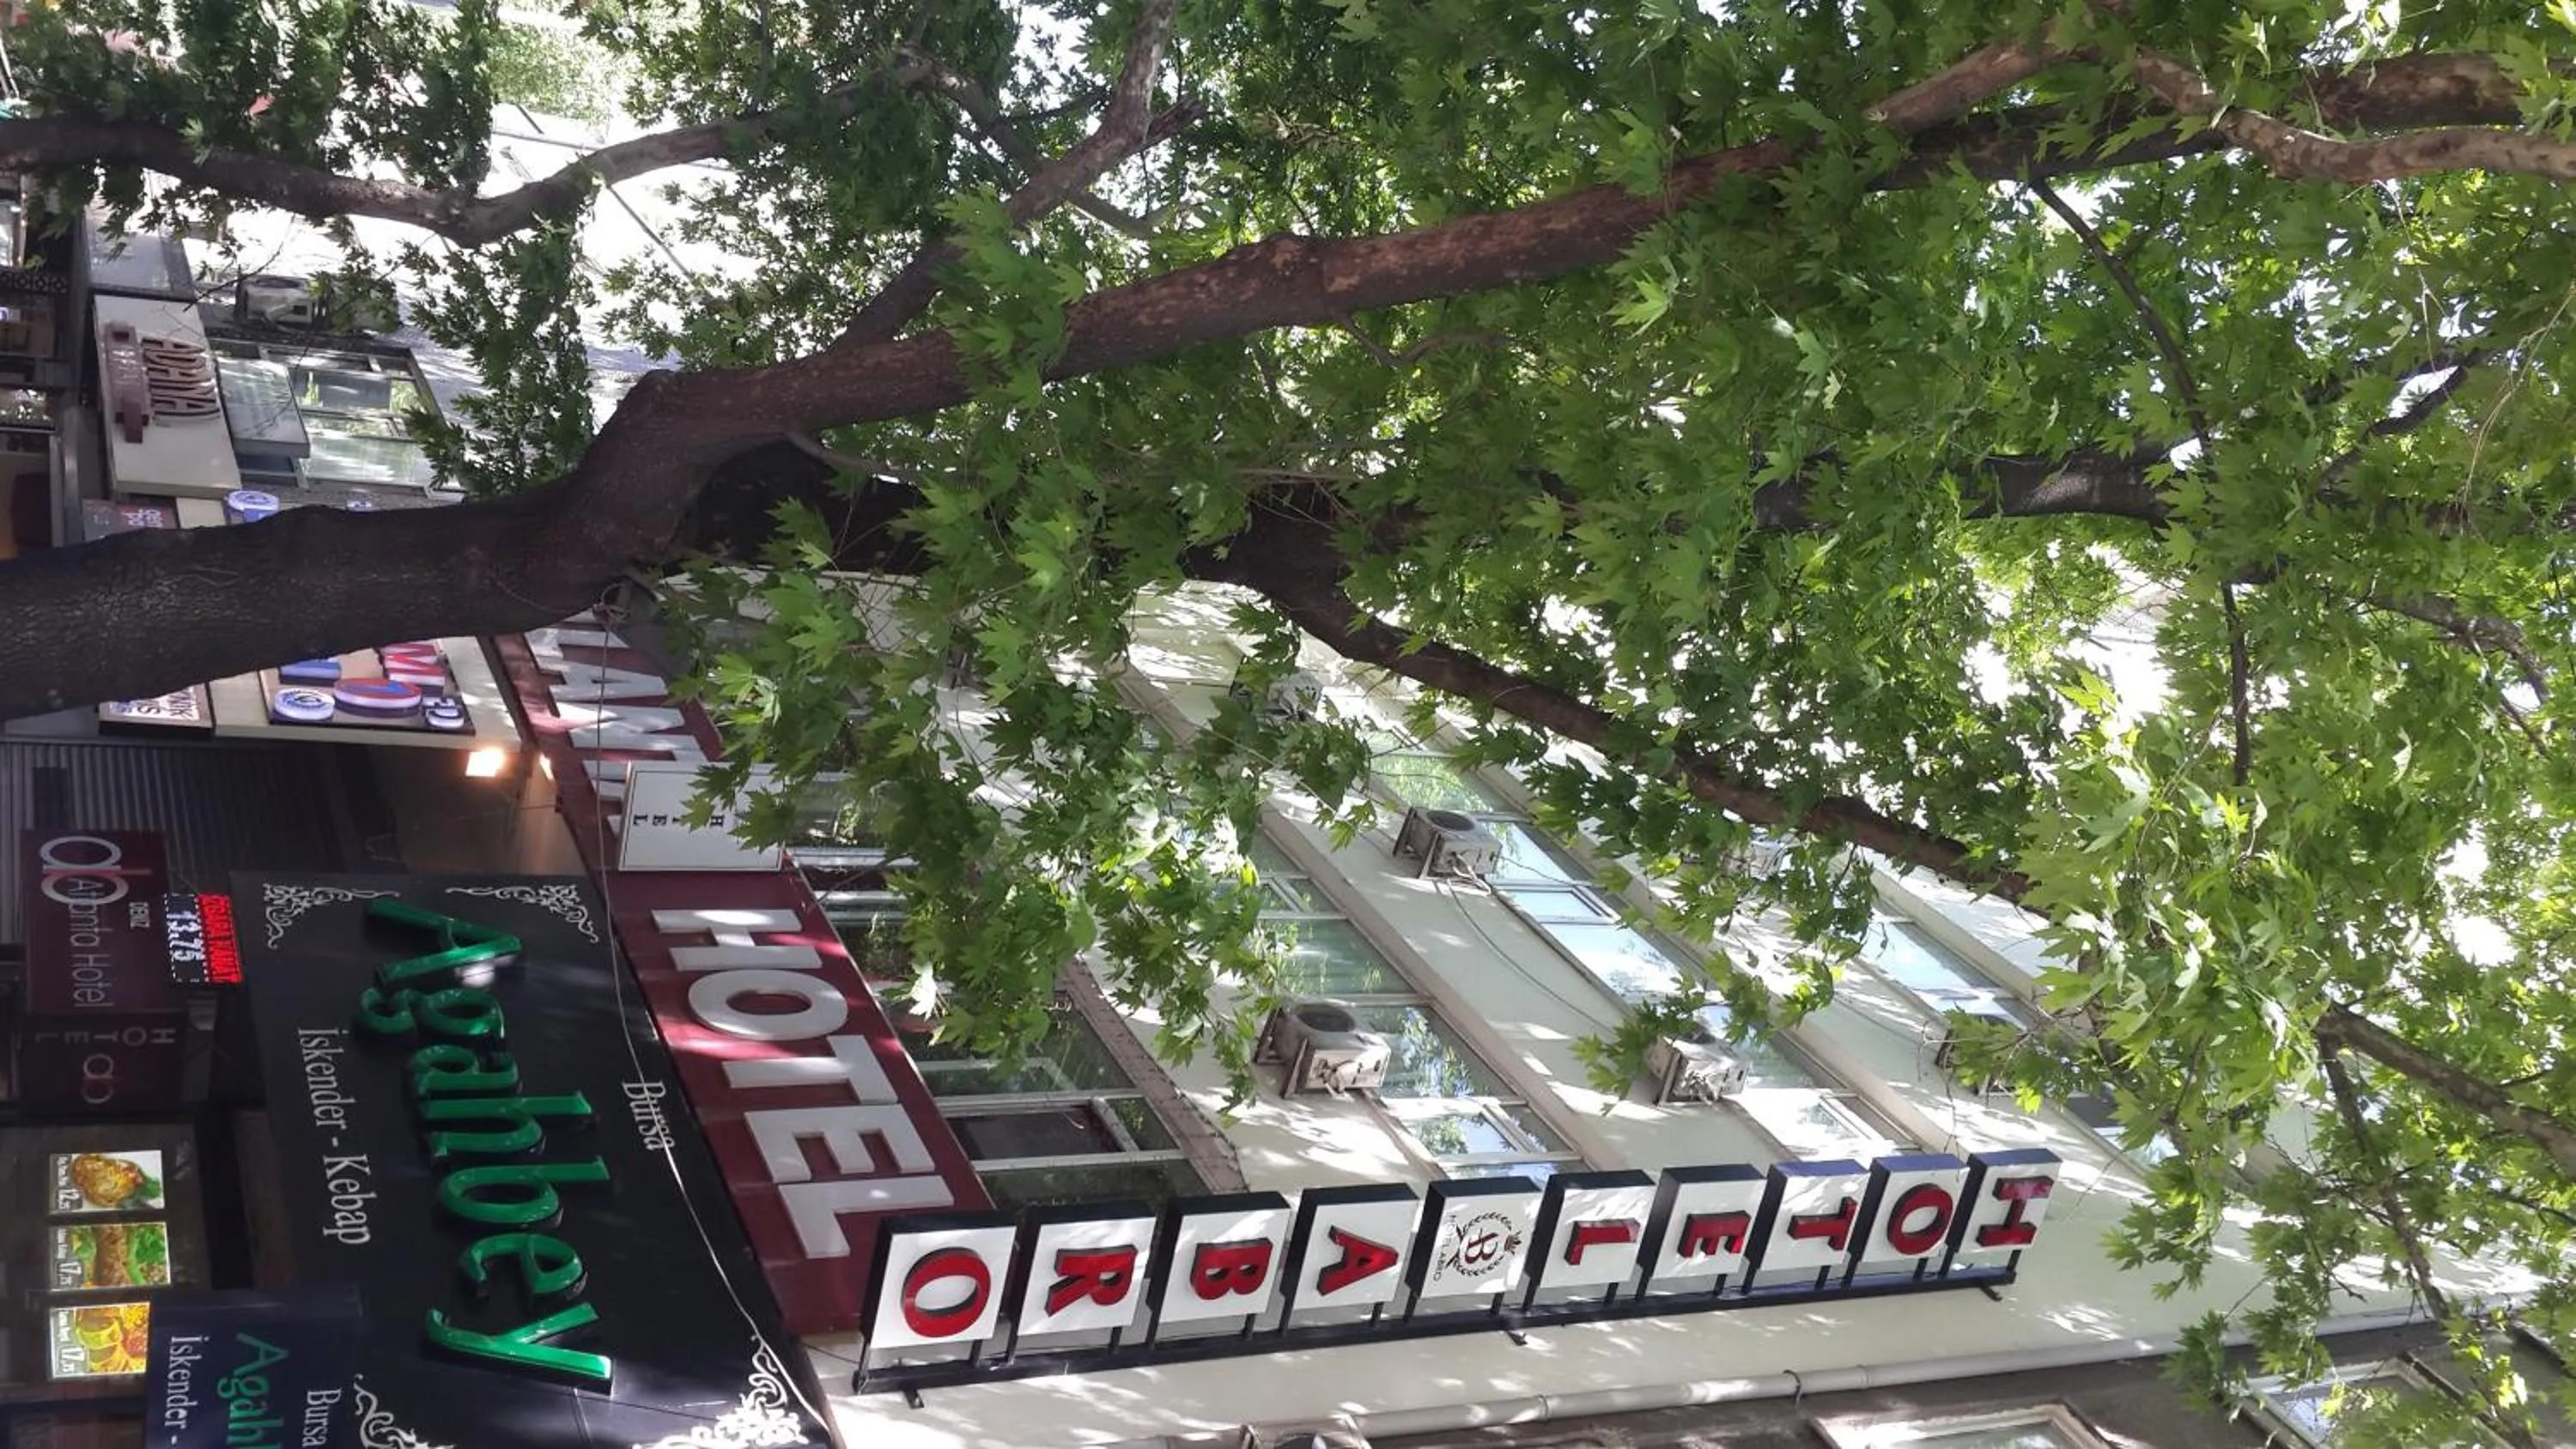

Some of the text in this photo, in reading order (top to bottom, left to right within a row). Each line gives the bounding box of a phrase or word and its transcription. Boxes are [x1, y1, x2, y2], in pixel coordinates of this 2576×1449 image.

[142, 336, 221, 417] ADANA
[167, 911, 205, 961] 13.75
[72, 953, 114, 1007] Hotel
[35, 1027, 175, 1046] HOTEL
[297, 1028, 355, 1129] İskender
[621, 1079, 677, 1151] Bursa
[651, 910, 953, 1257] HOTEL
[359, 900, 612, 1385] Agahbey
[320, 1155, 376, 1245] Kebap
[899, 1176, 2055, 1338] HOTEL ABRO
[164, 1335, 210, 1428] İskender
[302, 1387, 342, 1447] Bursa
